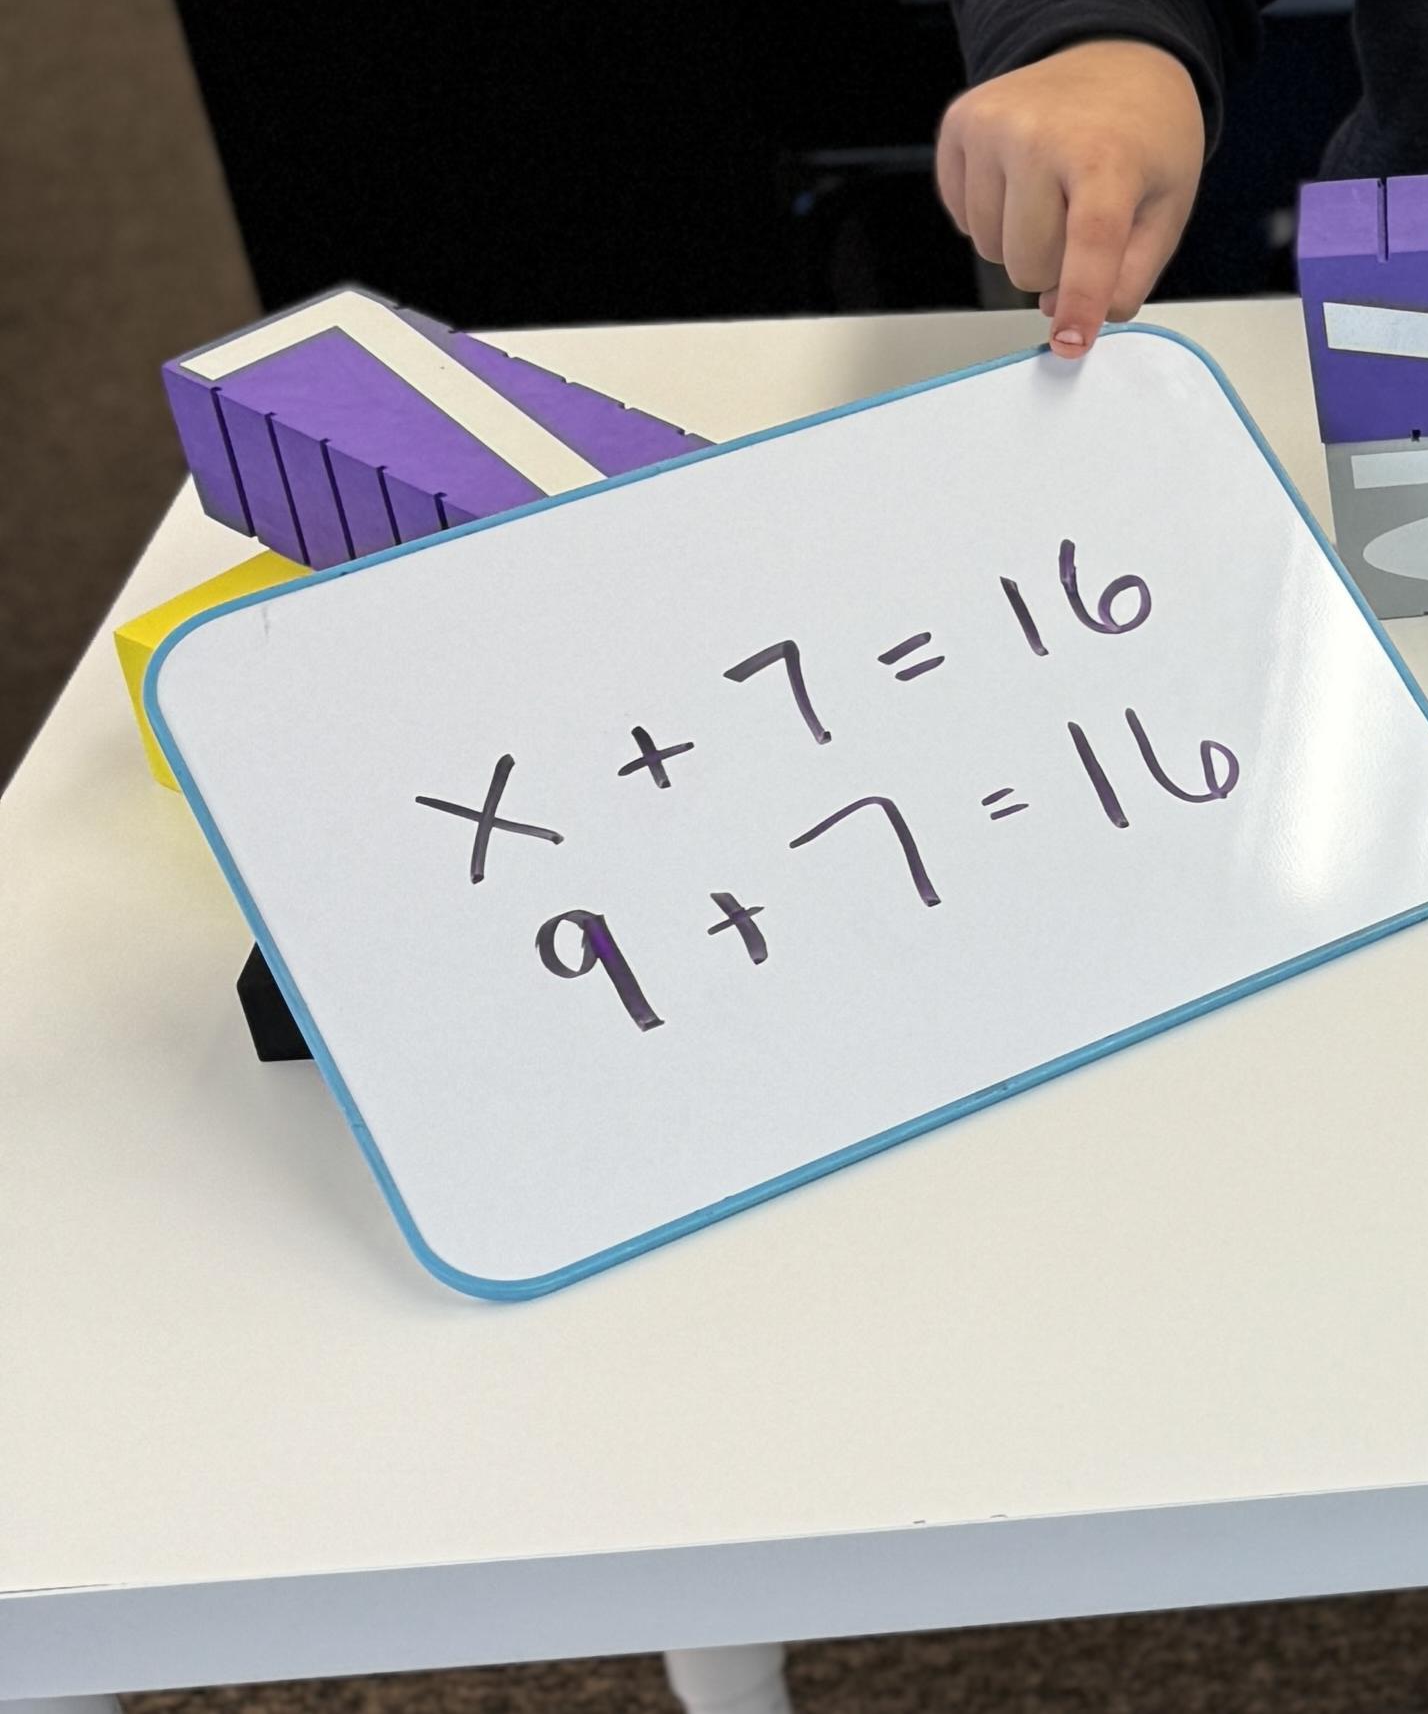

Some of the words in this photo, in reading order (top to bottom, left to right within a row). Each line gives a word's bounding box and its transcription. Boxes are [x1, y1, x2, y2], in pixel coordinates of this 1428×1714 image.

[723, 640, 831, 744] 7
[1000, 540, 1151, 656] 16
[535, 910, 664, 1031] 9
[790, 797, 941, 907] 7
[1068, 709, 1239, 828] 16
